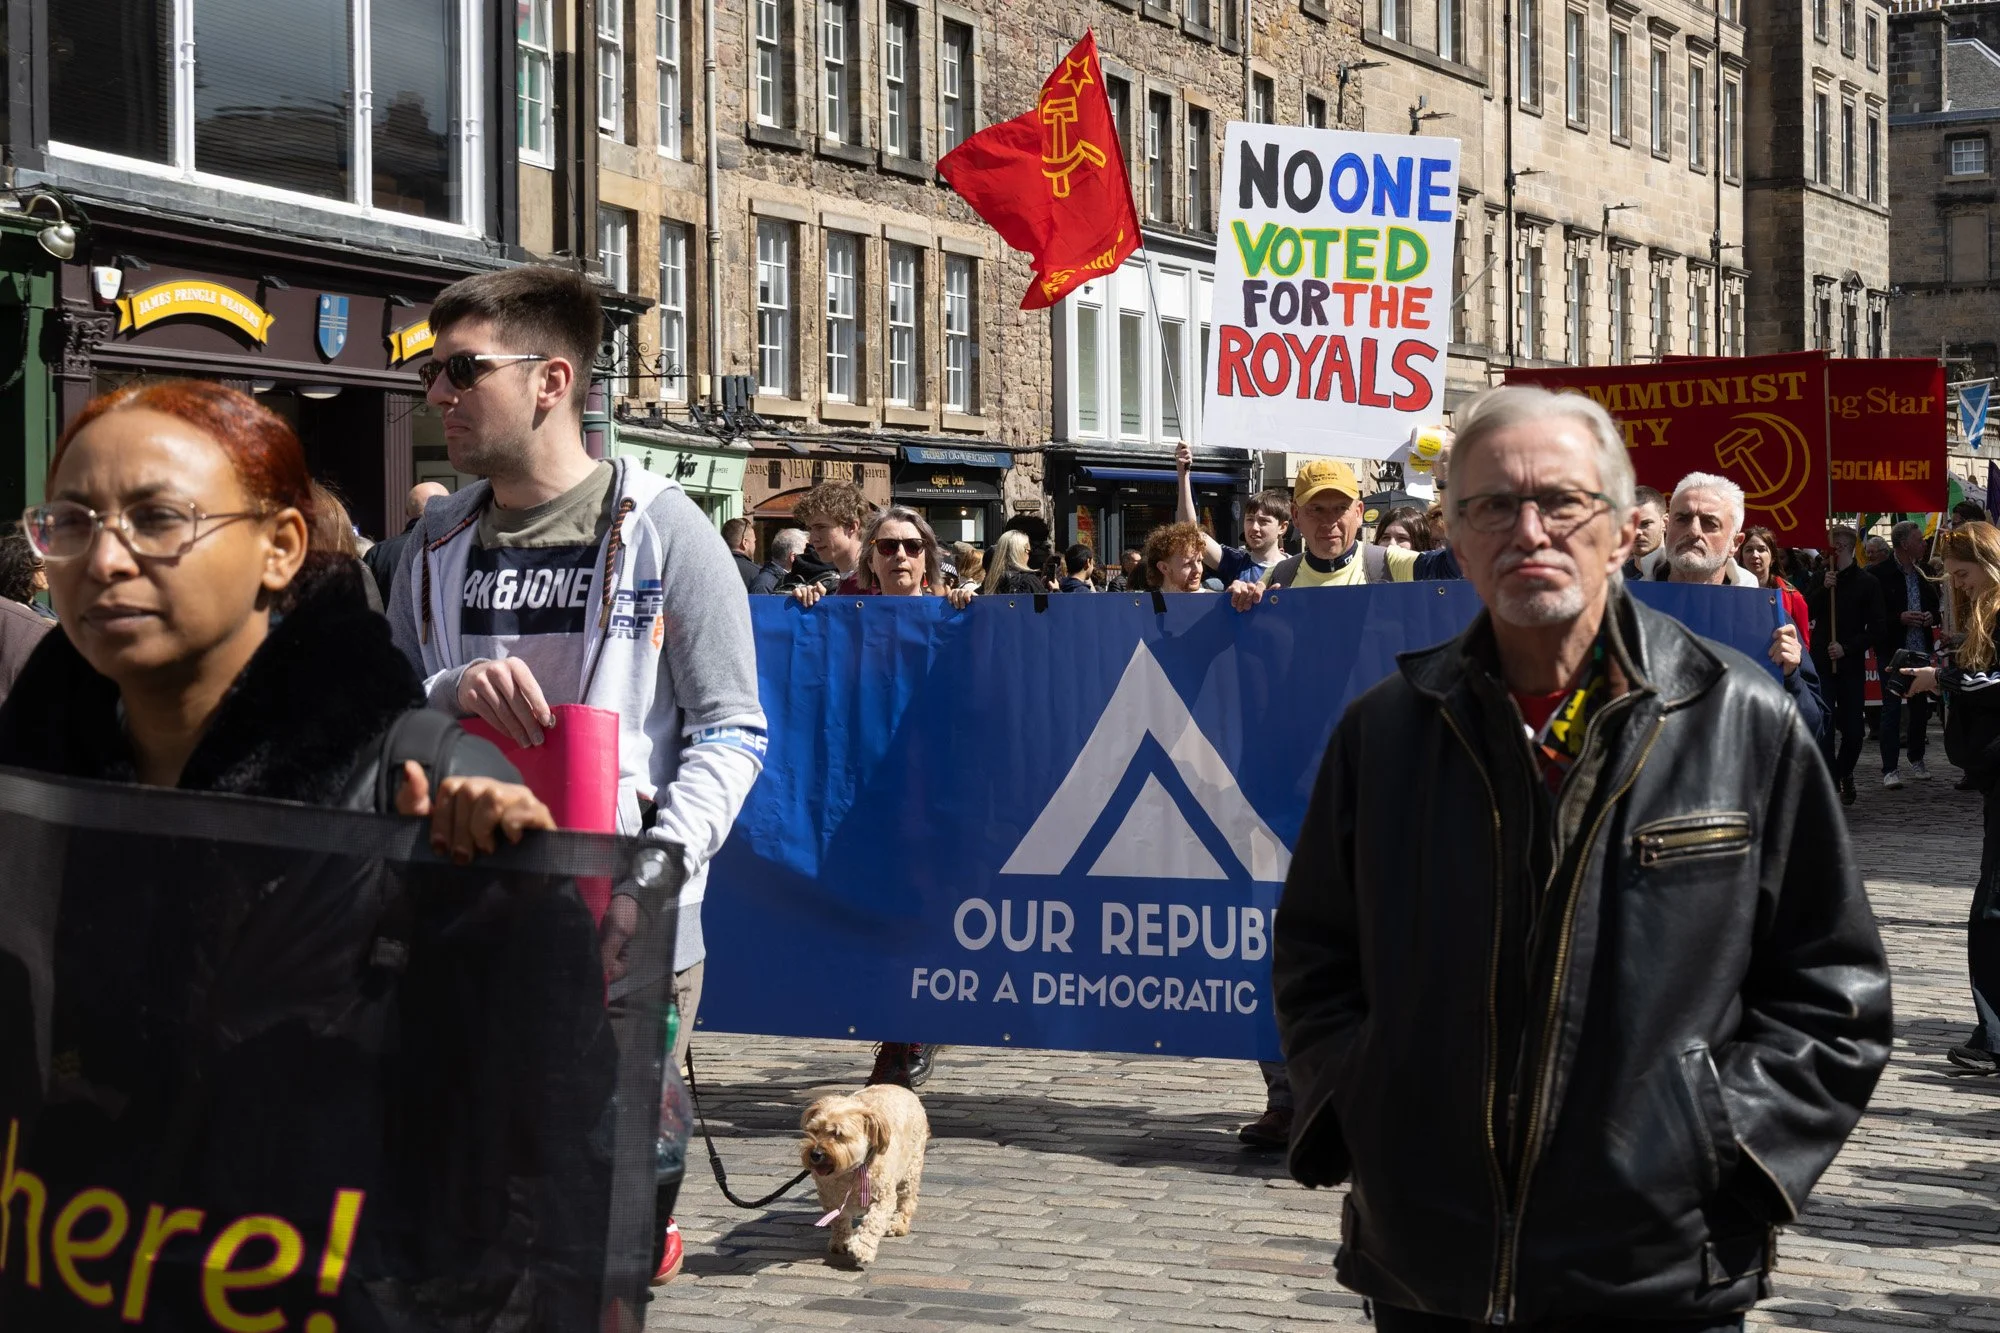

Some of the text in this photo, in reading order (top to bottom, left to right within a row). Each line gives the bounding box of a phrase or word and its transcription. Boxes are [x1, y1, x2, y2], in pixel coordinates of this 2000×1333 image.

[1239, 140, 1452, 222] NO ONE
[1231, 219, 1430, 283] VOTED
[139, 287, 260, 328] JAMES PRINGLE WEAVERS
[1242, 279, 1433, 329] FOR THE
[406, 327, 431, 349] JAMES
[1217, 325, 1439, 412] ROYALS
[1556, 371, 1806, 411] MMUNIST
[1866, 386, 1936, 415] Star
[789, 458, 853, 481] JEWELLERS
[1831, 460, 1931, 481] SOCIALISM
[954, 898, 1278, 961] OUR REPUB
[911, 967, 1258, 1015] FOR A DEMOCRATIC
